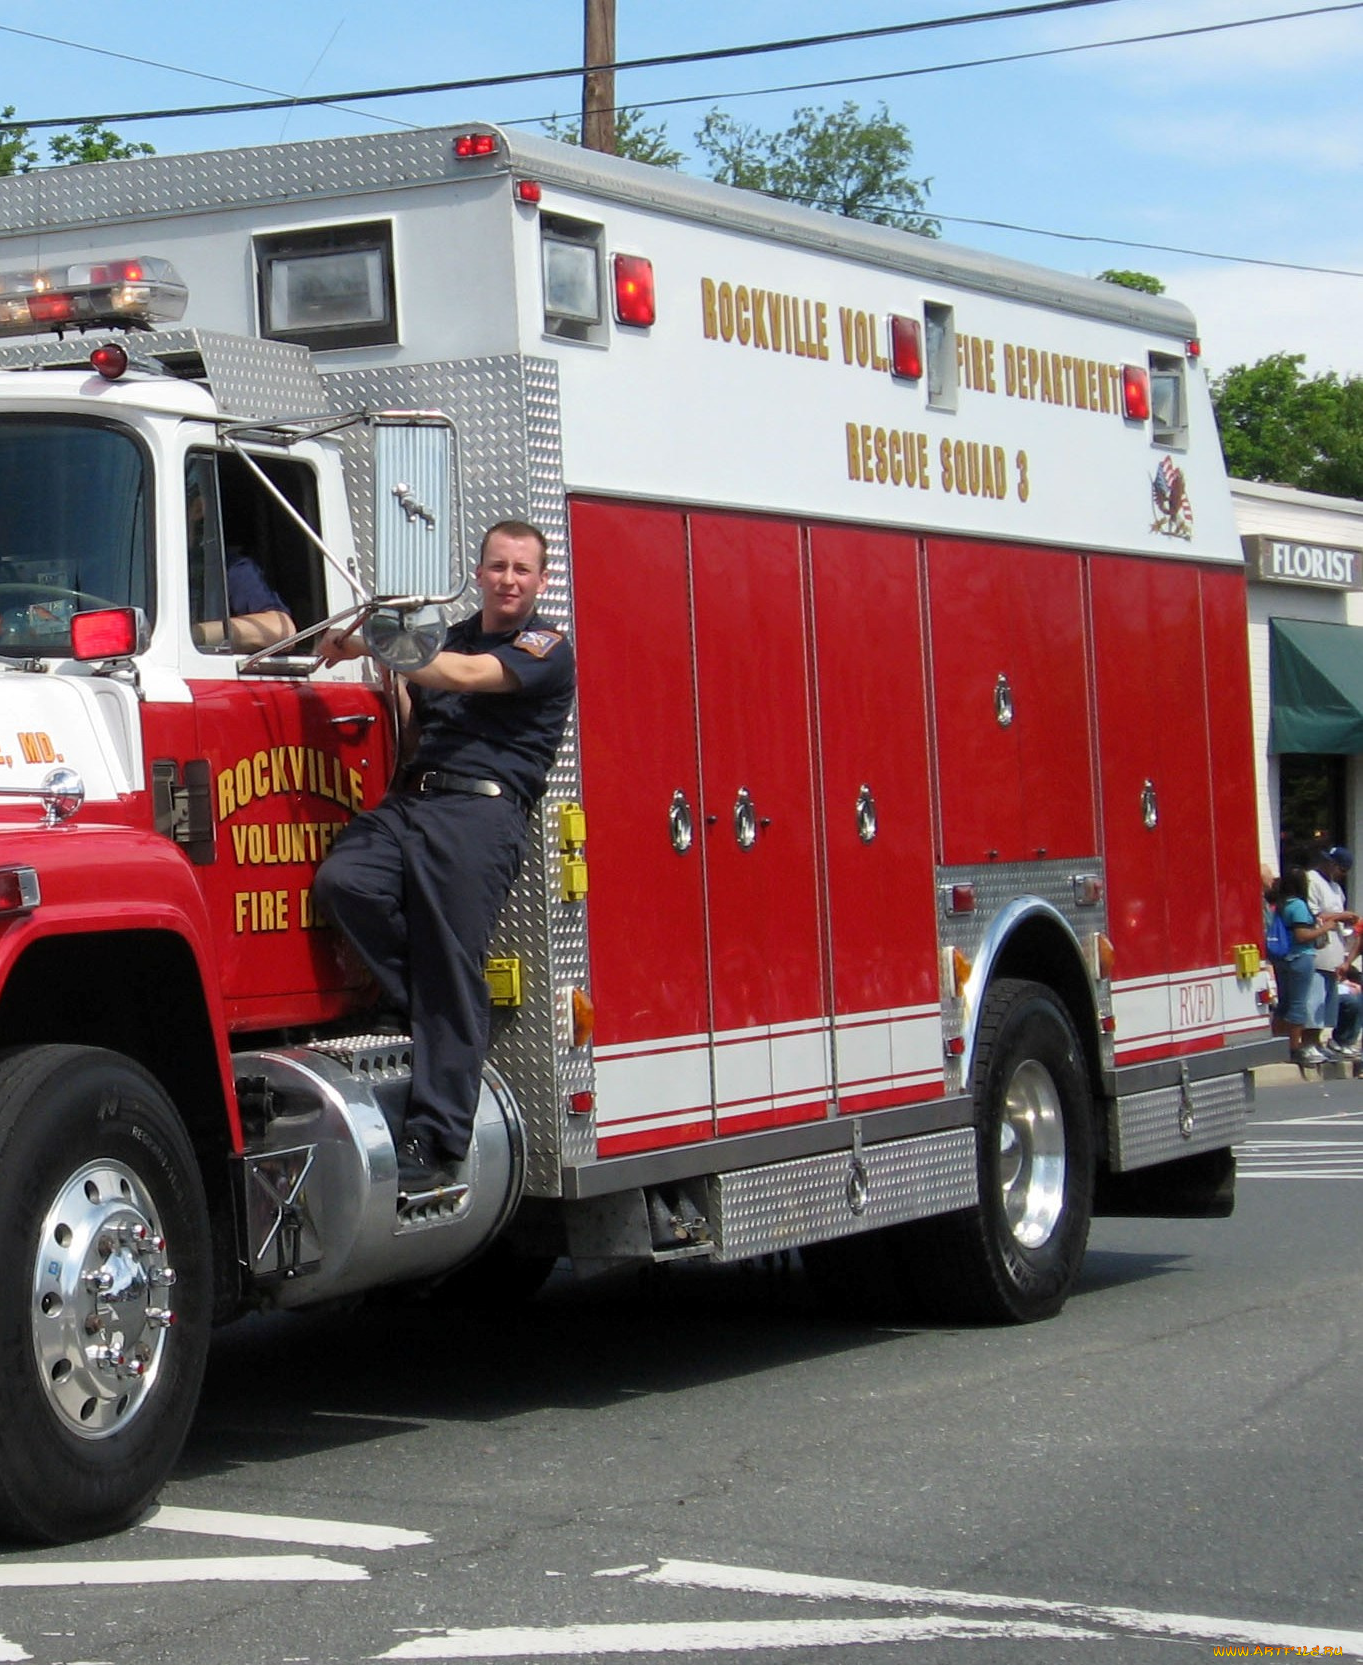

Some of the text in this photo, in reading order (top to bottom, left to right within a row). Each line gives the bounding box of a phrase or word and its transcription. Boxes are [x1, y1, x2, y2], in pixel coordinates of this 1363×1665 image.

[701, 277, 1119, 415] ROCKVILLE VOL. FIRE DEPARTMENT
[845, 422, 1029, 503] RESCUE SQUAD 3
[1273, 542, 1355, 583] FLORIST
[17, 732, 64, 764] MD.
[217, 745, 364, 822] ROCKVILLE
[231, 822, 344, 865] VOLUNTE
[235, 890, 289, 933] FIRE
[1180, 983, 1215, 1026] RVFD
